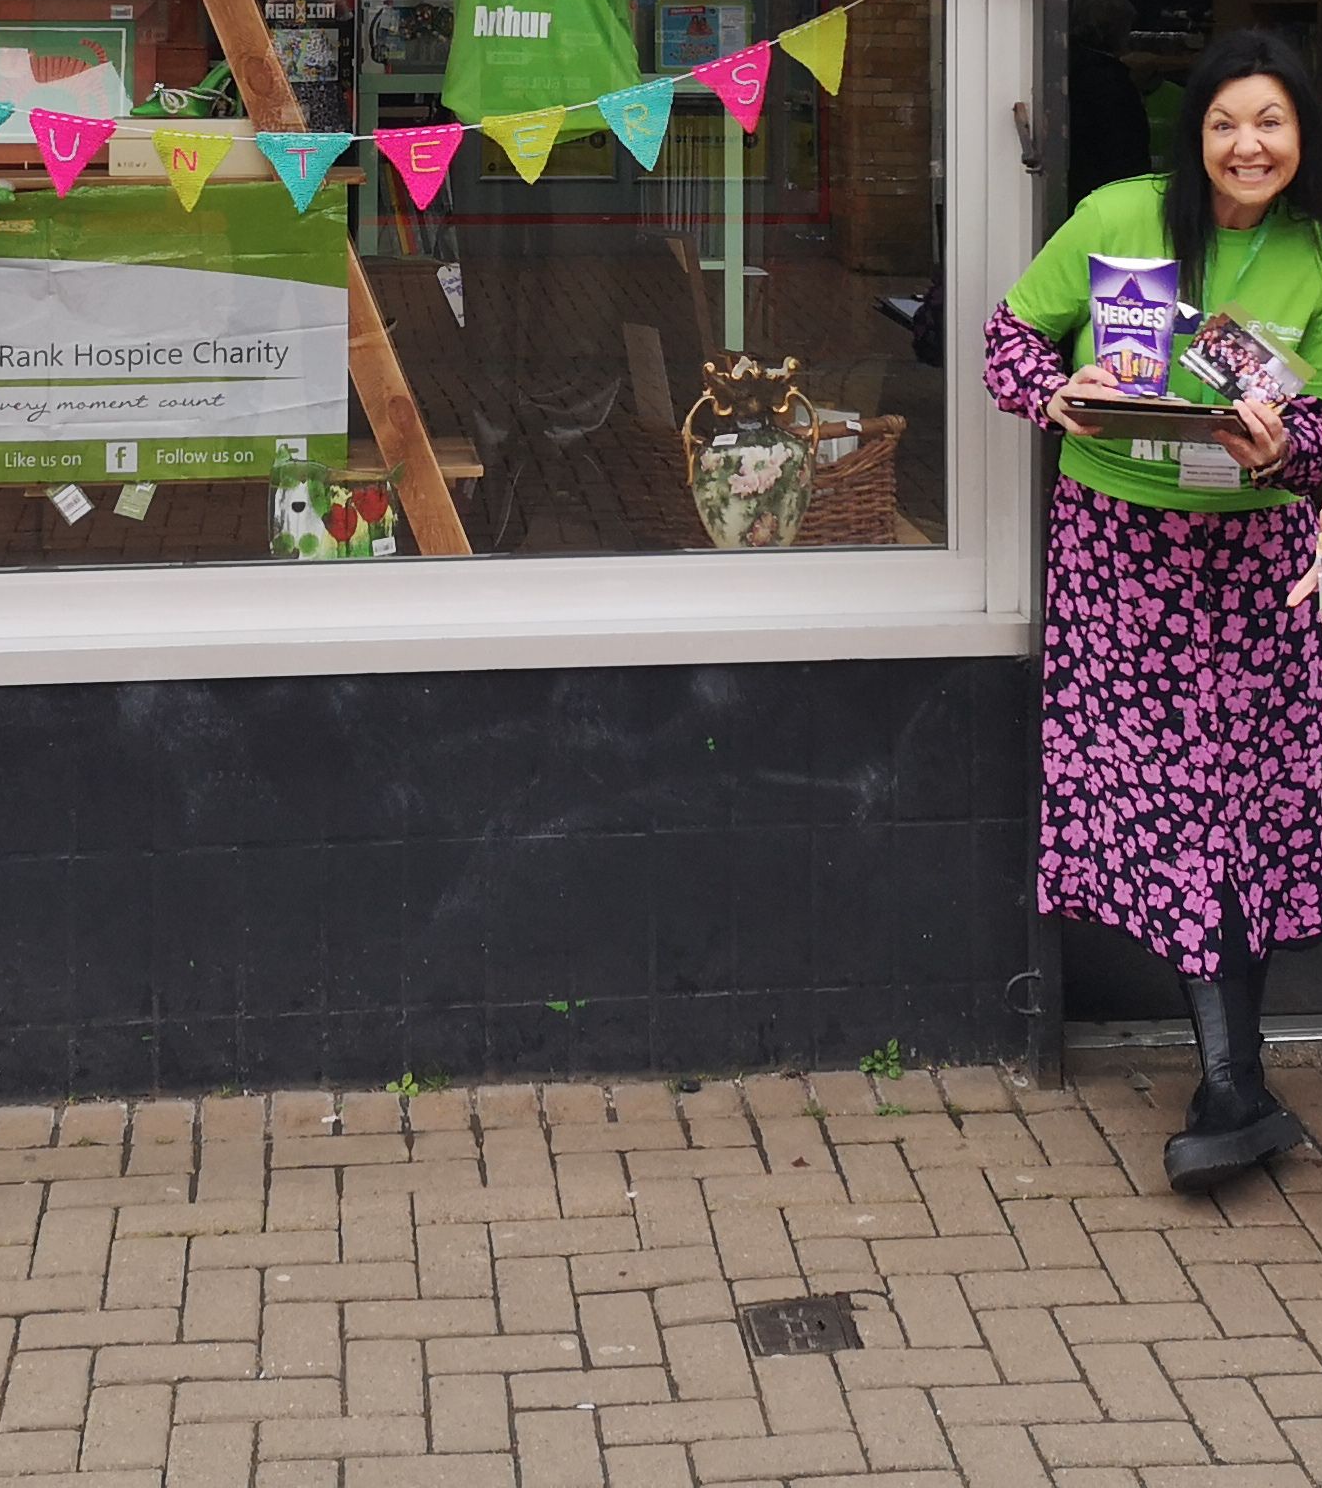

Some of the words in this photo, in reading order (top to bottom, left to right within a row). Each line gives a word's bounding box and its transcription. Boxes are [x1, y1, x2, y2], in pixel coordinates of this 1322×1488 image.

[474, 5, 551, 39] Arthur
[1096, 300, 1167, 330] HEROES
[75, 342, 184, 373] Hospice
[192, 340, 289, 369] Charity
[56, 395, 149, 411] moment
[159, 393, 227, 410] count
[4, 452, 35, 469] Like
[38, 456, 57, 468] us
[61, 455, 83, 468] on
[156, 448, 208, 465] Follow
[212, 451, 230, 465] us
[233, 451, 255, 464] on
